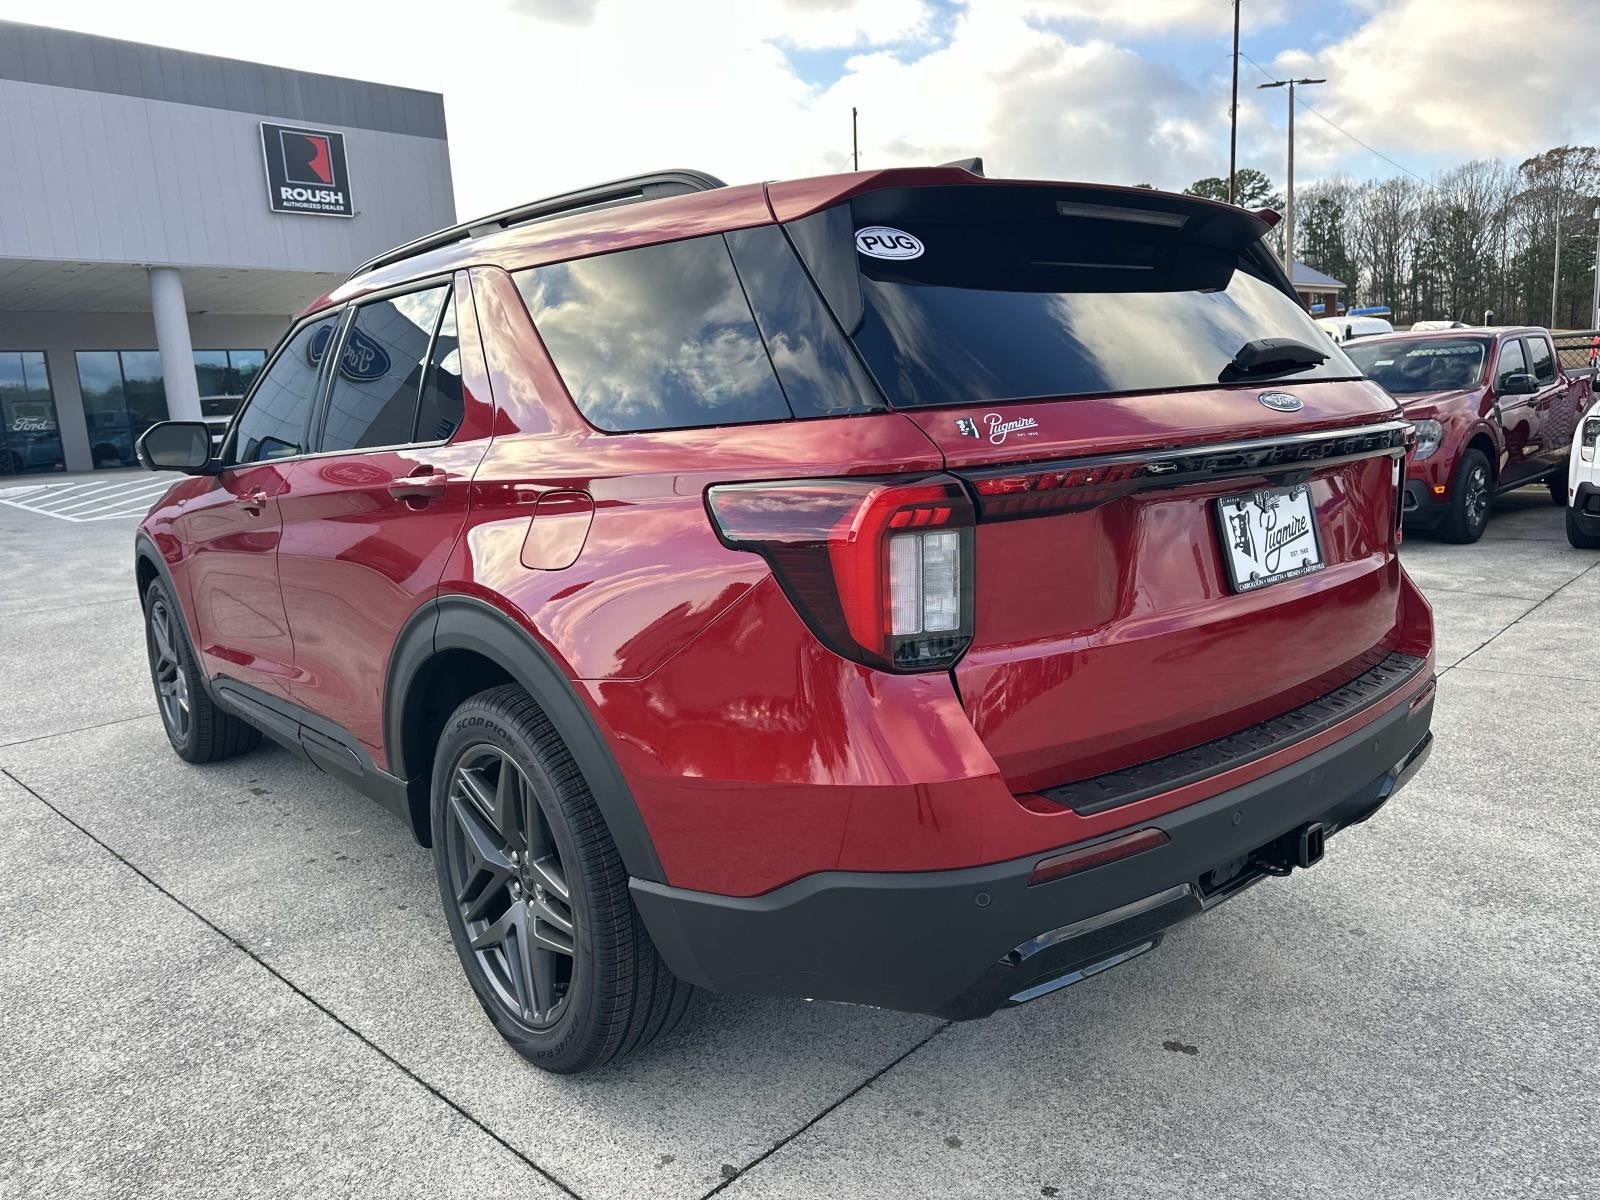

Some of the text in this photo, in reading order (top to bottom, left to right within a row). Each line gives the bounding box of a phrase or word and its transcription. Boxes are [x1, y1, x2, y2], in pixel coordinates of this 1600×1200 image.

[280, 187, 344, 204] ROUSH
[283, 201, 344, 211] AUTHORIZED DEALER
[861, 235, 917, 251] PUG
[13, 417, 48, 431] Ford
[984, 413, 1039, 445] Pugmire
[1260, 508, 1310, 574] Pugmire
[456, 716, 518, 746] SCORPION
